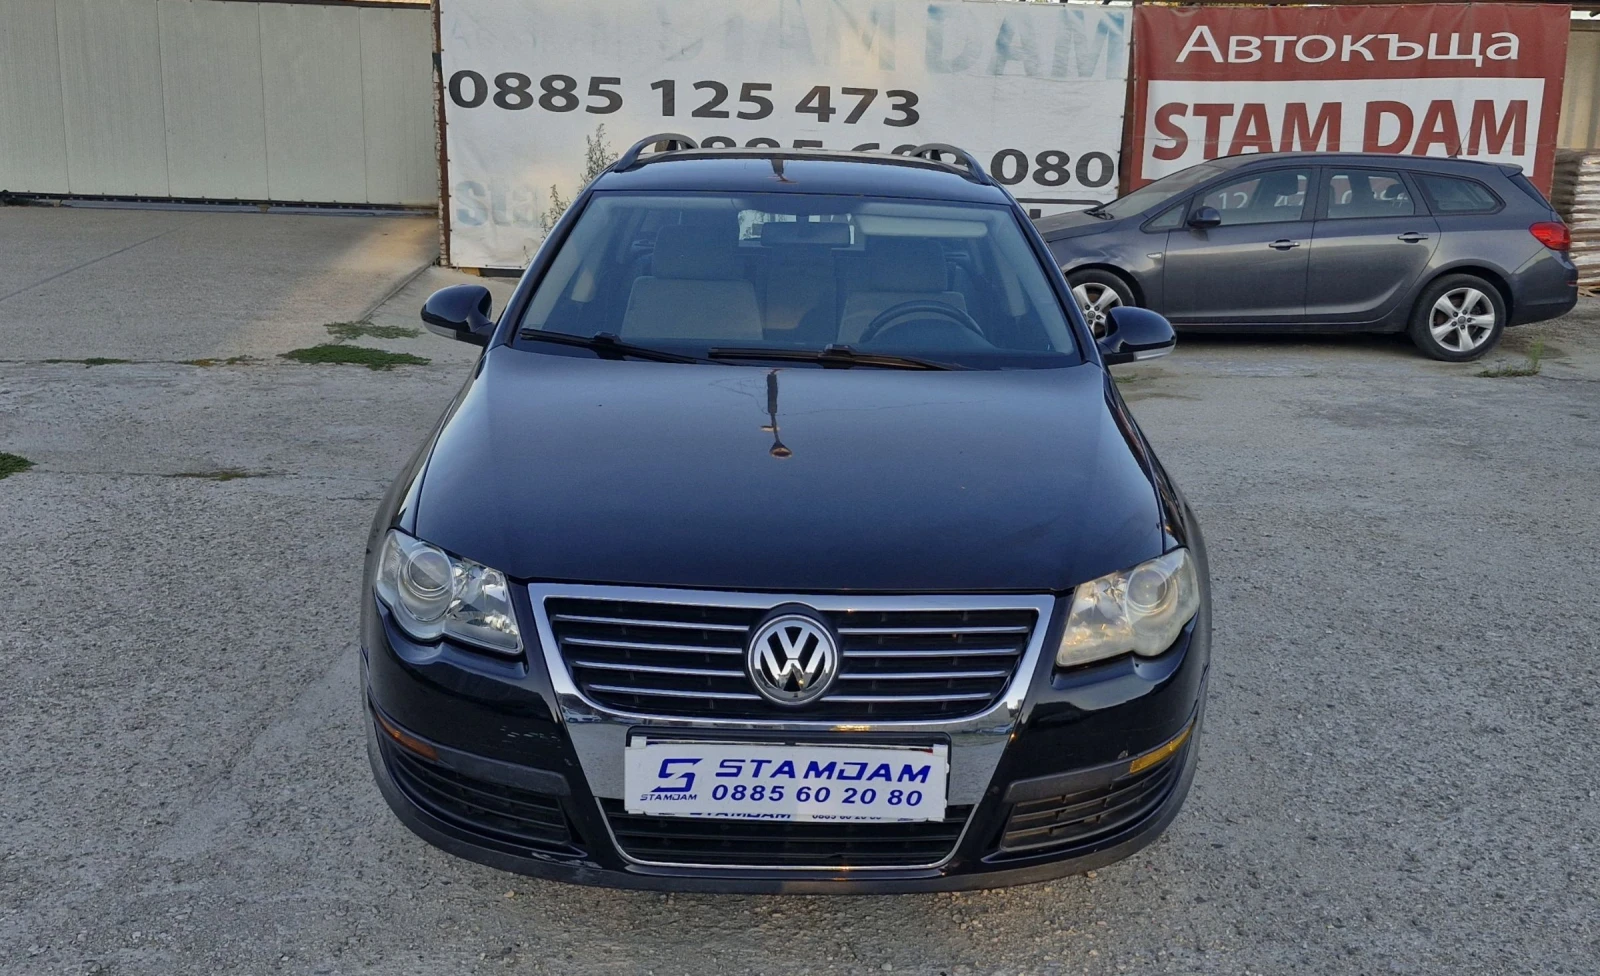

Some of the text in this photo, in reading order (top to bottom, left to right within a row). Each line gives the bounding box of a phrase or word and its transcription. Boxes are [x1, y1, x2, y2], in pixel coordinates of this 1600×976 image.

[1175, 25, 1519, 67] Автокъща
[449, 70, 920, 127] 0885 125 473
[1151, 100, 1528, 160] STAM DAM
[990, 149, 1115, 188] 080
[715, 759, 931, 784] STAMDAM
[640, 793, 698, 802] STAMDAM
[711, 784, 923, 807] 0885 60 20 80
